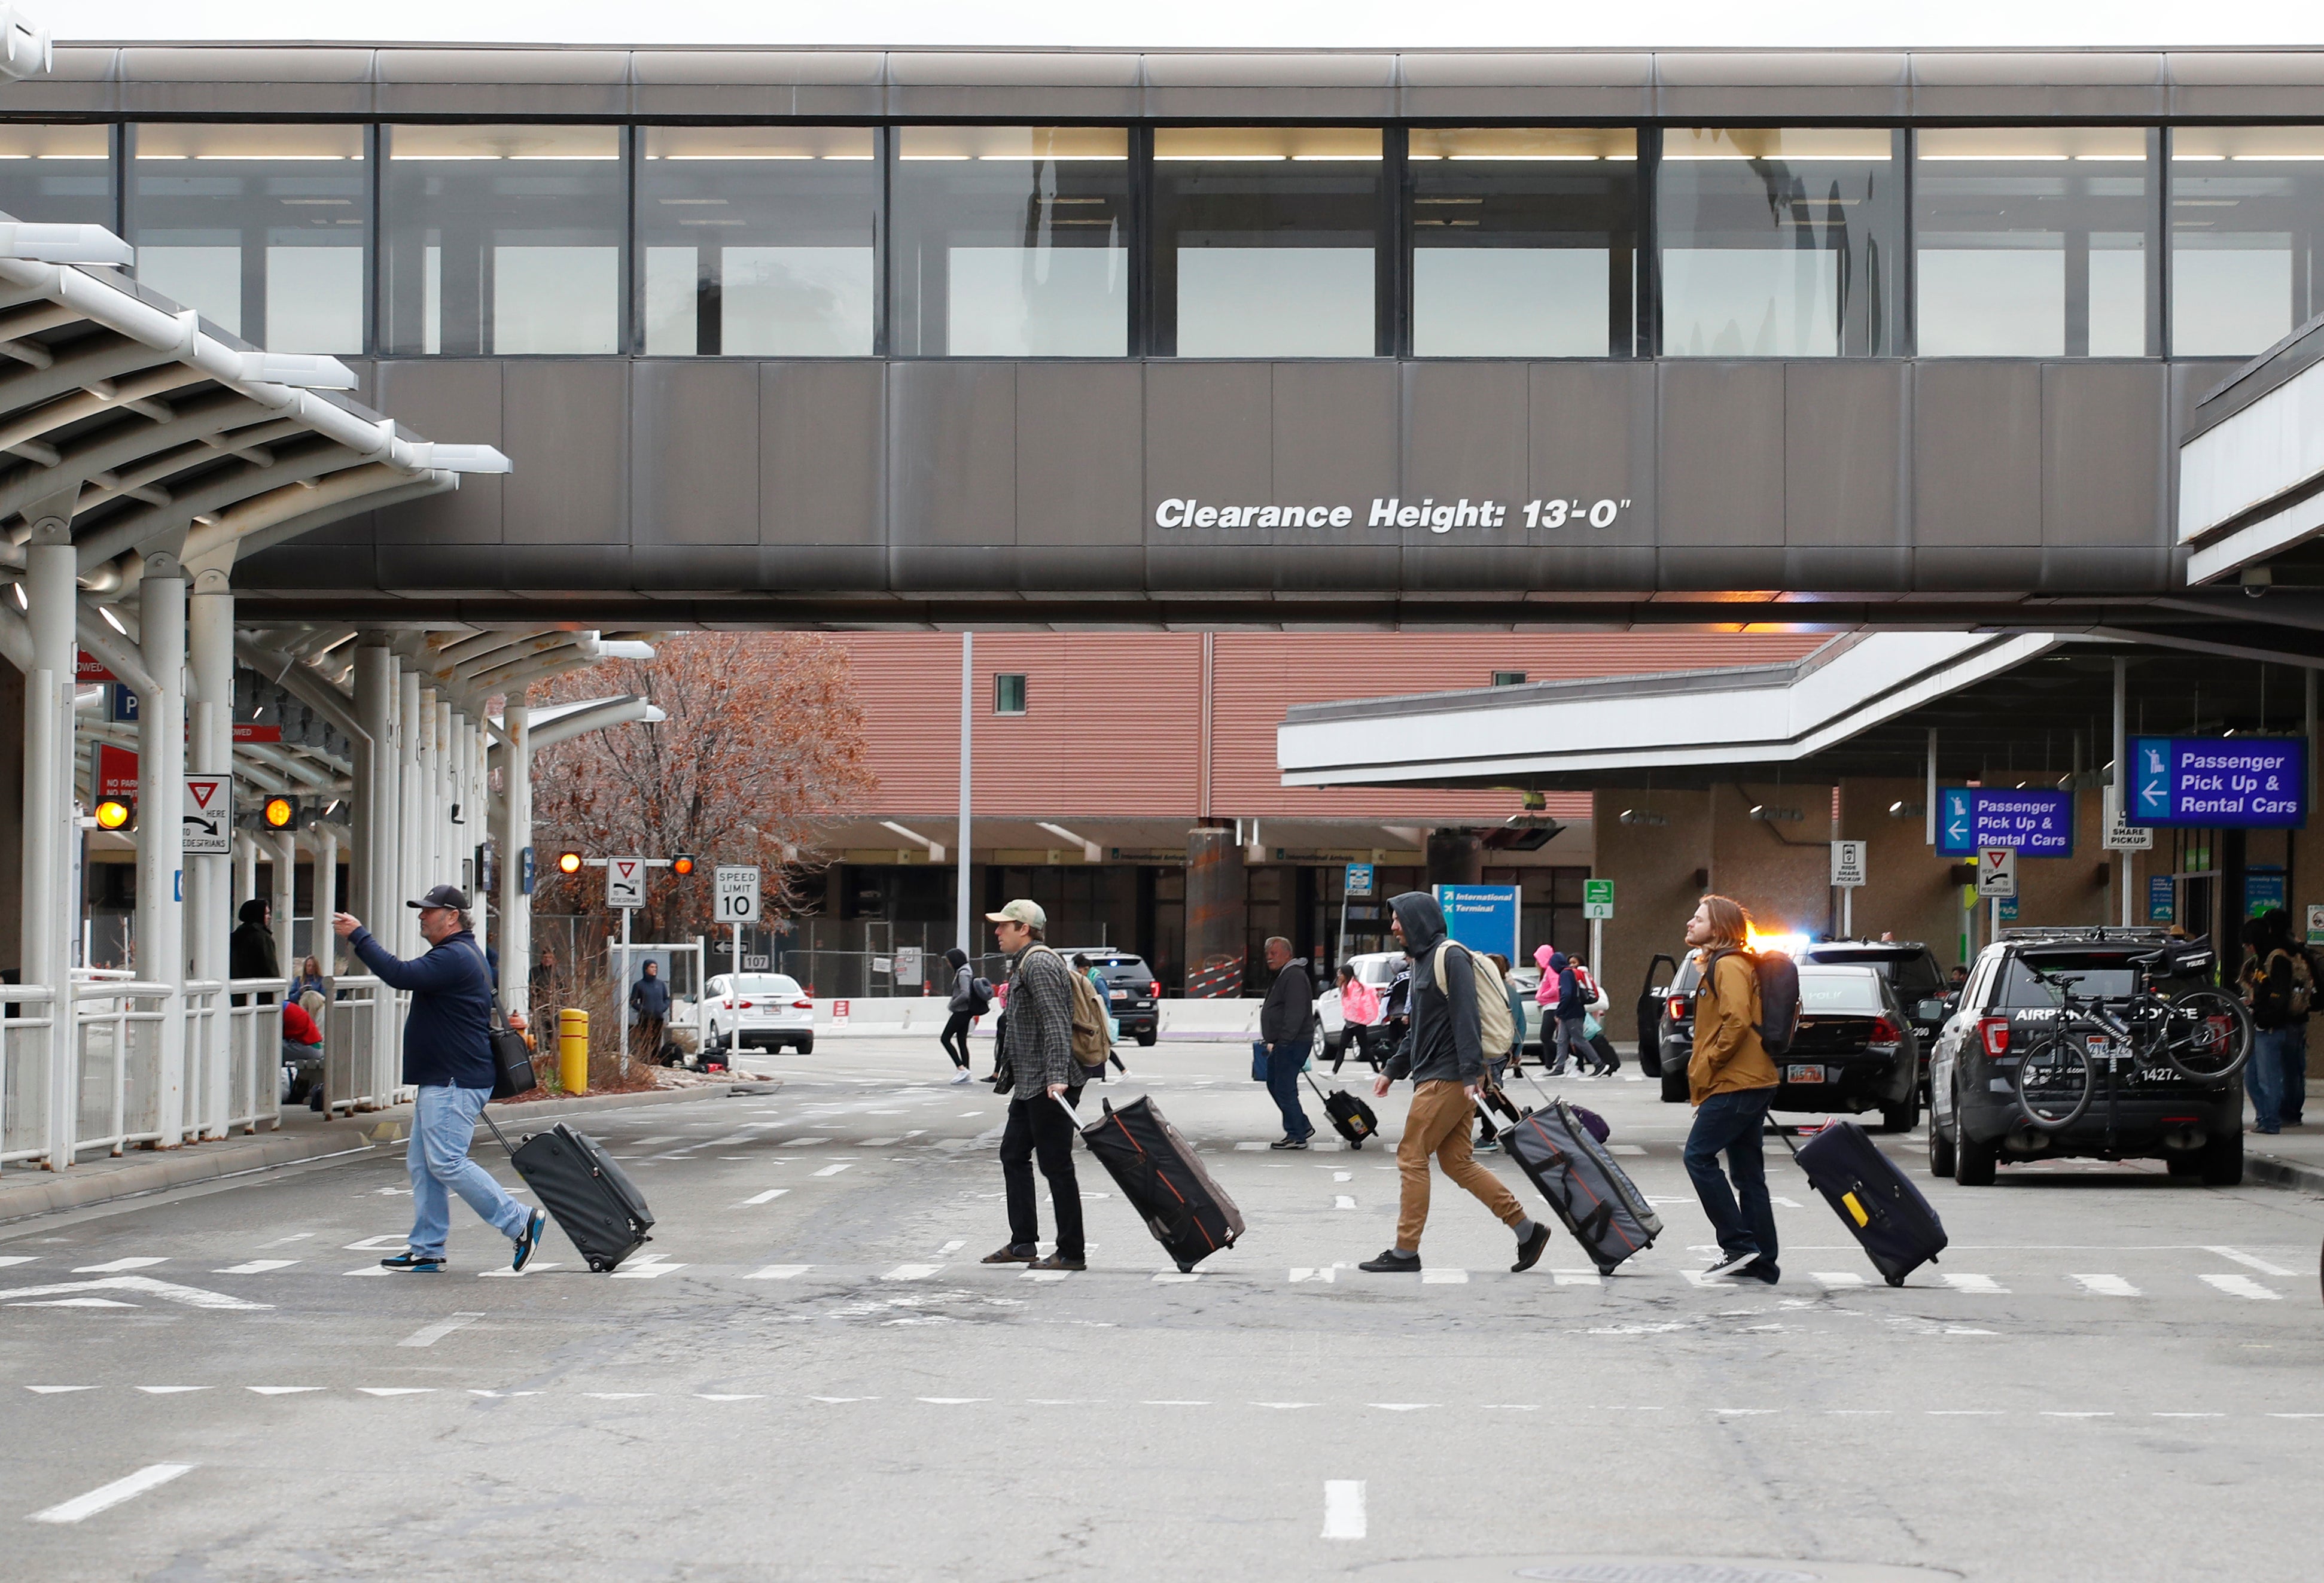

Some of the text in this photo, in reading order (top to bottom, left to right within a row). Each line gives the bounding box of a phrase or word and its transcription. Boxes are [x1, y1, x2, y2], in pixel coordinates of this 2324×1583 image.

[1155, 498, 1631, 533] Clearance Height: 13'-0"
[2180, 753, 2285, 772] Passenger
[2180, 775, 2280, 794] Pick Up &
[1978, 800, 2057, 815] Passenger
[2180, 797, 2298, 813] Rental Cars
[1977, 817, 2052, 832] Pick Up &
[183, 839, 226, 847] EDESTRIANS
[1978, 833, 2066, 846] Rental Cars
[719, 873, 756, 882] SPEED
[723, 884, 751, 893] LIMIT
[724, 896, 750, 915] 10
[748, 957, 765, 967] 107
